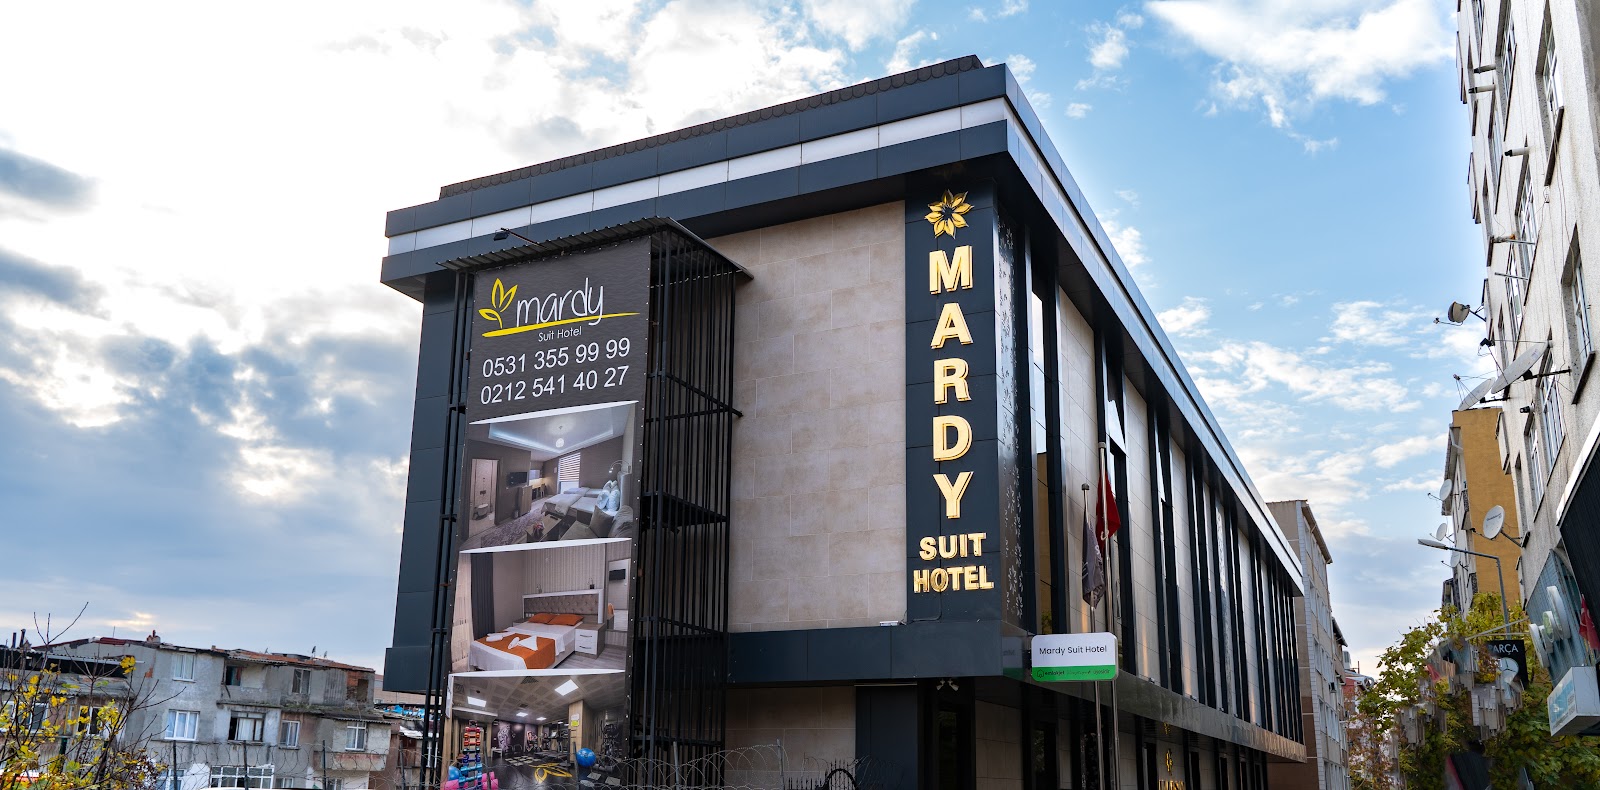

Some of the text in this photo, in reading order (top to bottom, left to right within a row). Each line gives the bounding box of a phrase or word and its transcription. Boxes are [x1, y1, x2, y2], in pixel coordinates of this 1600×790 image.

[516, 277, 604, 328] mardy
[538, 326, 582, 343] Suit Hotel
[482, 337, 631, 378] 0531 355 99 99
[480, 365, 630, 405] 0212 541 40 27
[928, 244, 974, 519] MARDY
[918, 532, 987, 561] SUIT
[913, 565, 995, 594] HOTEL
[1039, 645, 1107, 656] Mardy Suit Hotel
